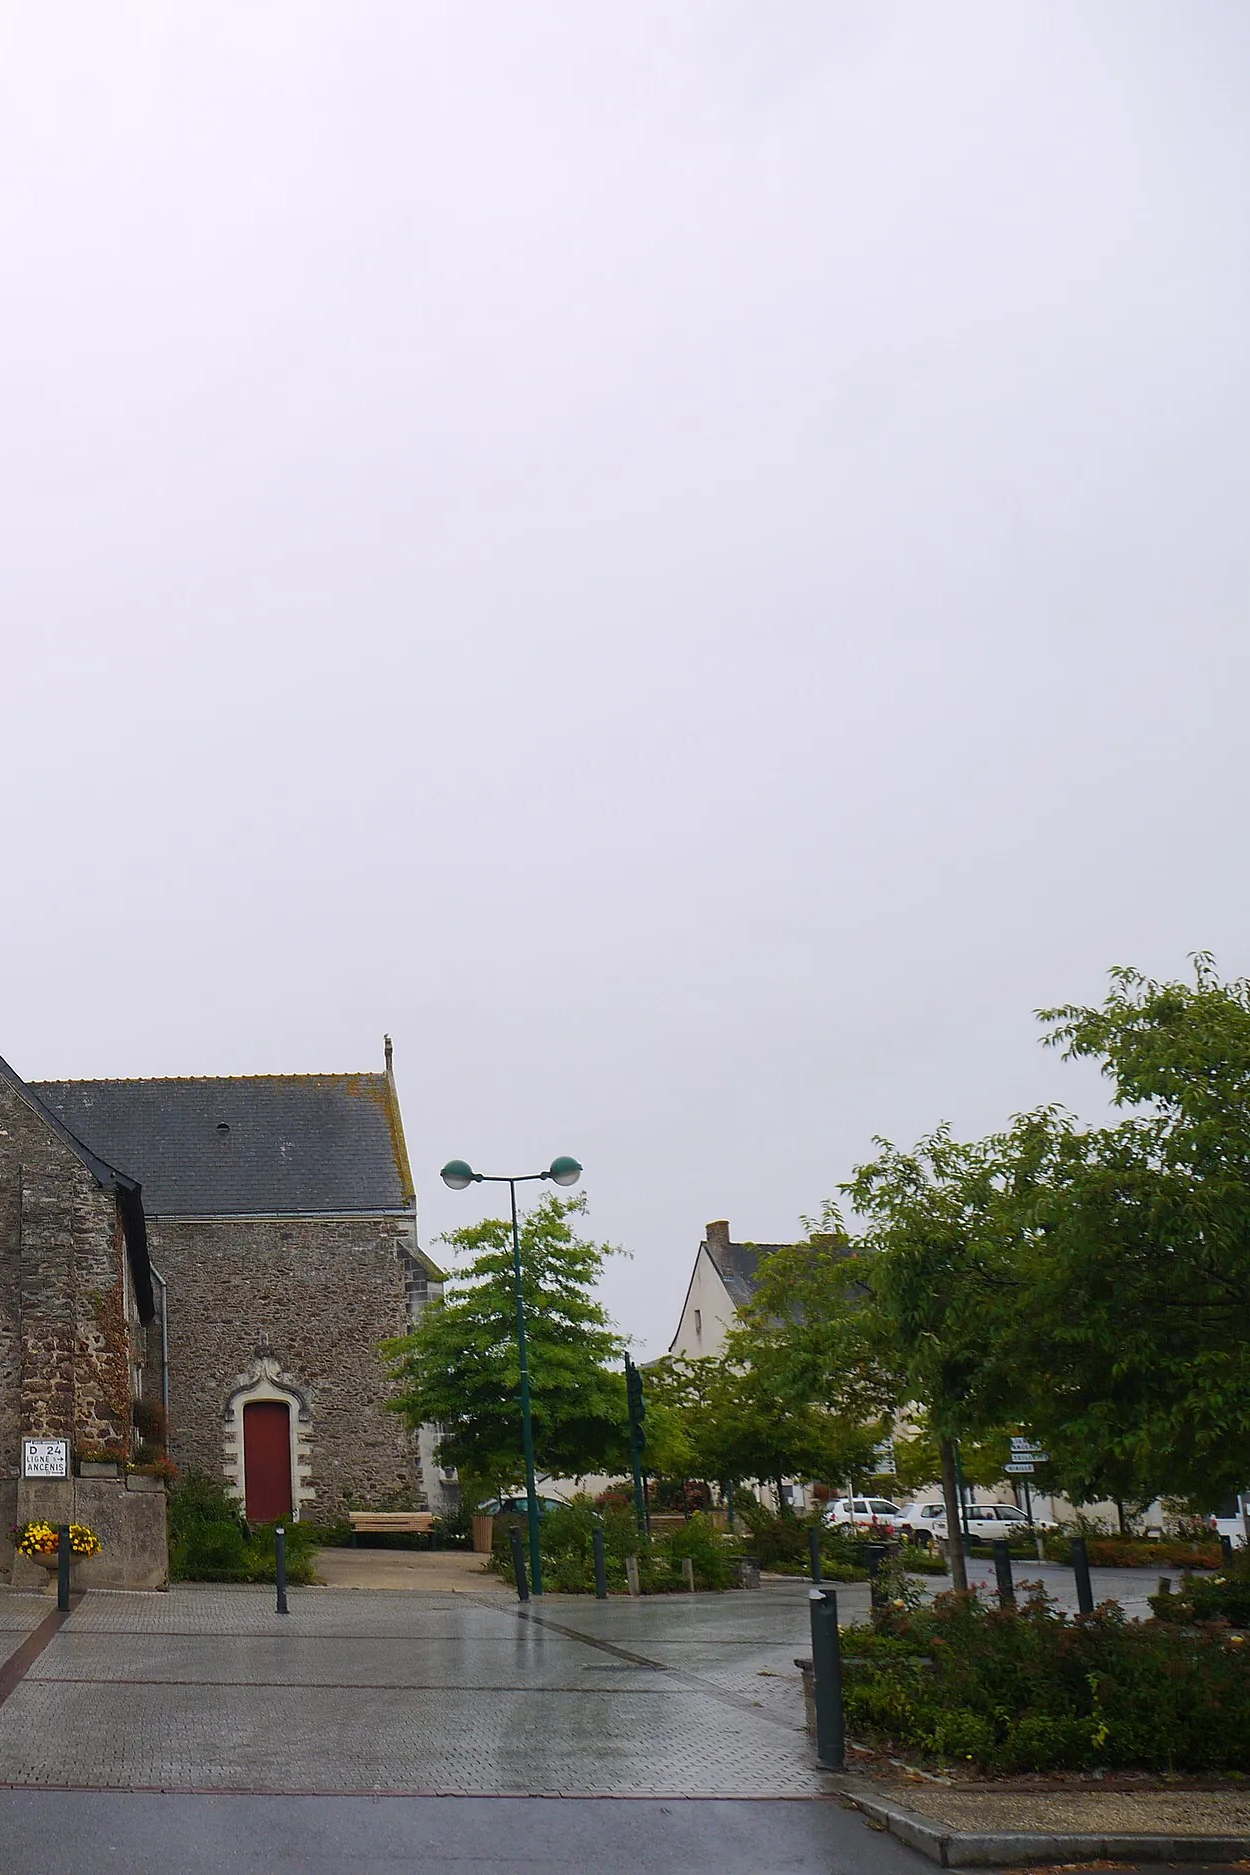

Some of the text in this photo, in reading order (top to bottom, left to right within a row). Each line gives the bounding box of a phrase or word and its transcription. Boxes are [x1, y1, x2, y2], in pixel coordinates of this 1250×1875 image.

[29, 1445, 62, 1455] D 24
[27, 1463, 64, 1471] ANCENIS
